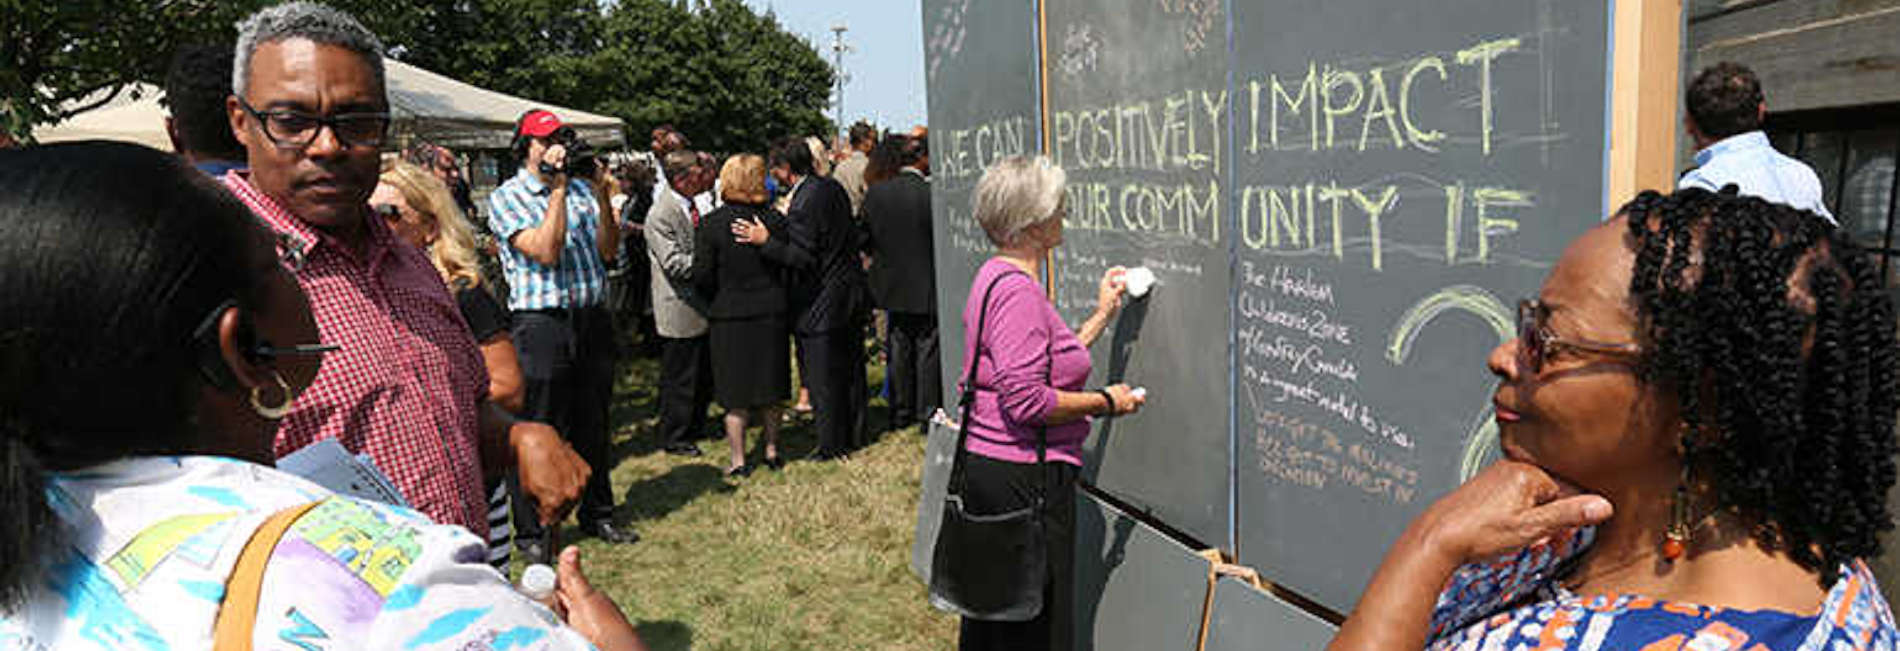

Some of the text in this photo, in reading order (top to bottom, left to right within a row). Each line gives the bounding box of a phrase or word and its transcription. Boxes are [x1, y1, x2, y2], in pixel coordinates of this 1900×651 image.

[934, 38, 1520, 188] WE CAN POSITIVELY IMPACT
[1062, 180, 1525, 270] OUR COMM UNITY IF
